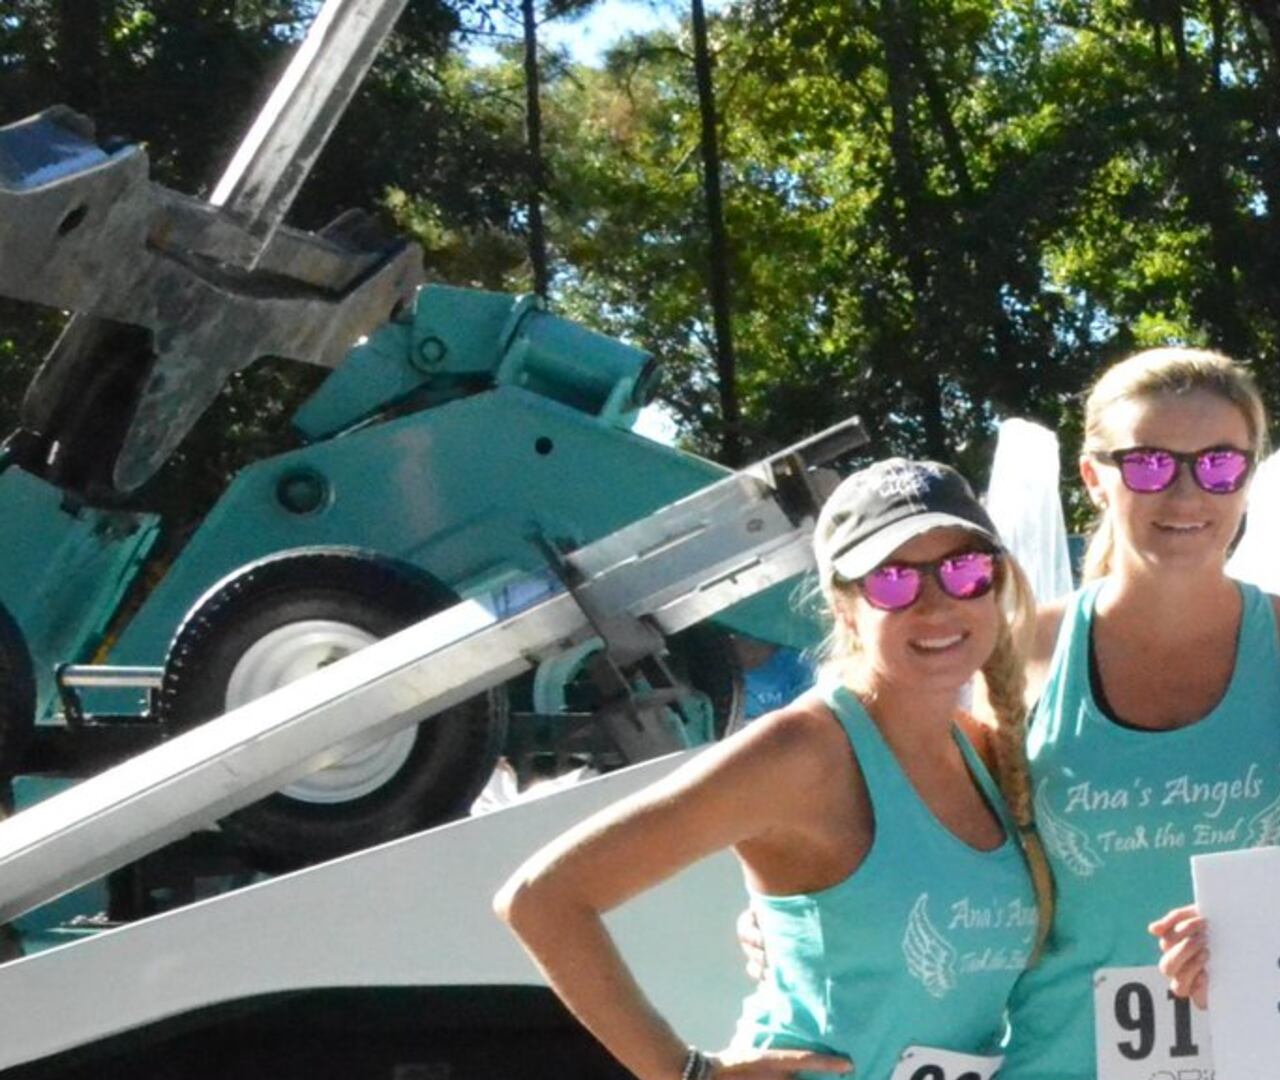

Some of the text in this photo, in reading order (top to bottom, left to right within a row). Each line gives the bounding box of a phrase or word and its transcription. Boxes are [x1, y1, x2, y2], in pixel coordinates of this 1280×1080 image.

[1064, 763, 1263, 819] Ana's Angels
[1154, 822, 1185, 848] the
[1192, 818, 1244, 846] End
[1114, 981, 1199, 1061] 91
